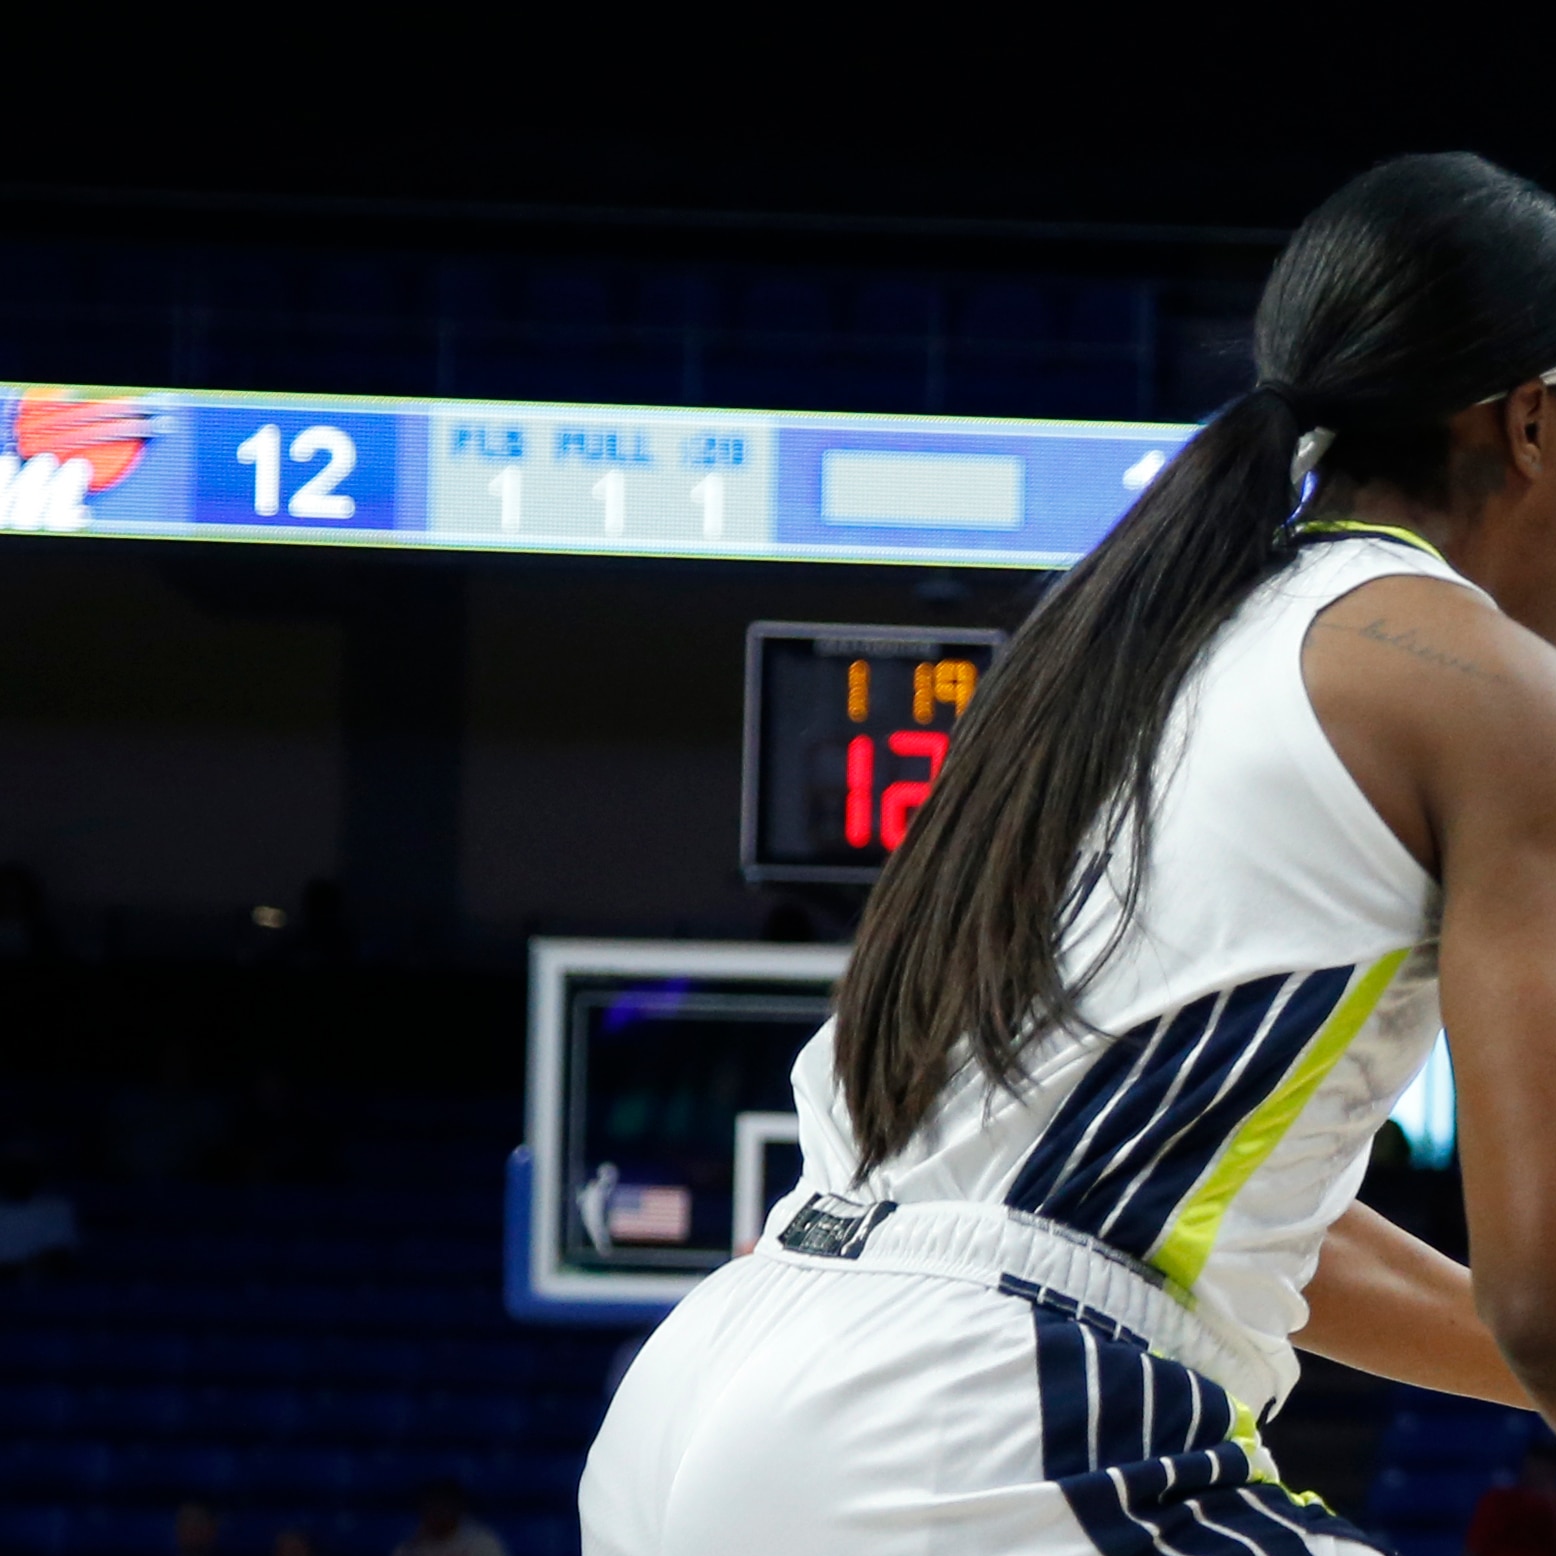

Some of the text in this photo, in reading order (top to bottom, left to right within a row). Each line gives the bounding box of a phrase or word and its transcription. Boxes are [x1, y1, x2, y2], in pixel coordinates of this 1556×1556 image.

[236, 422, 357, 521] 12
[488, 465, 724, 541] 1 1 1
[845, 729, 950, 853] 12
